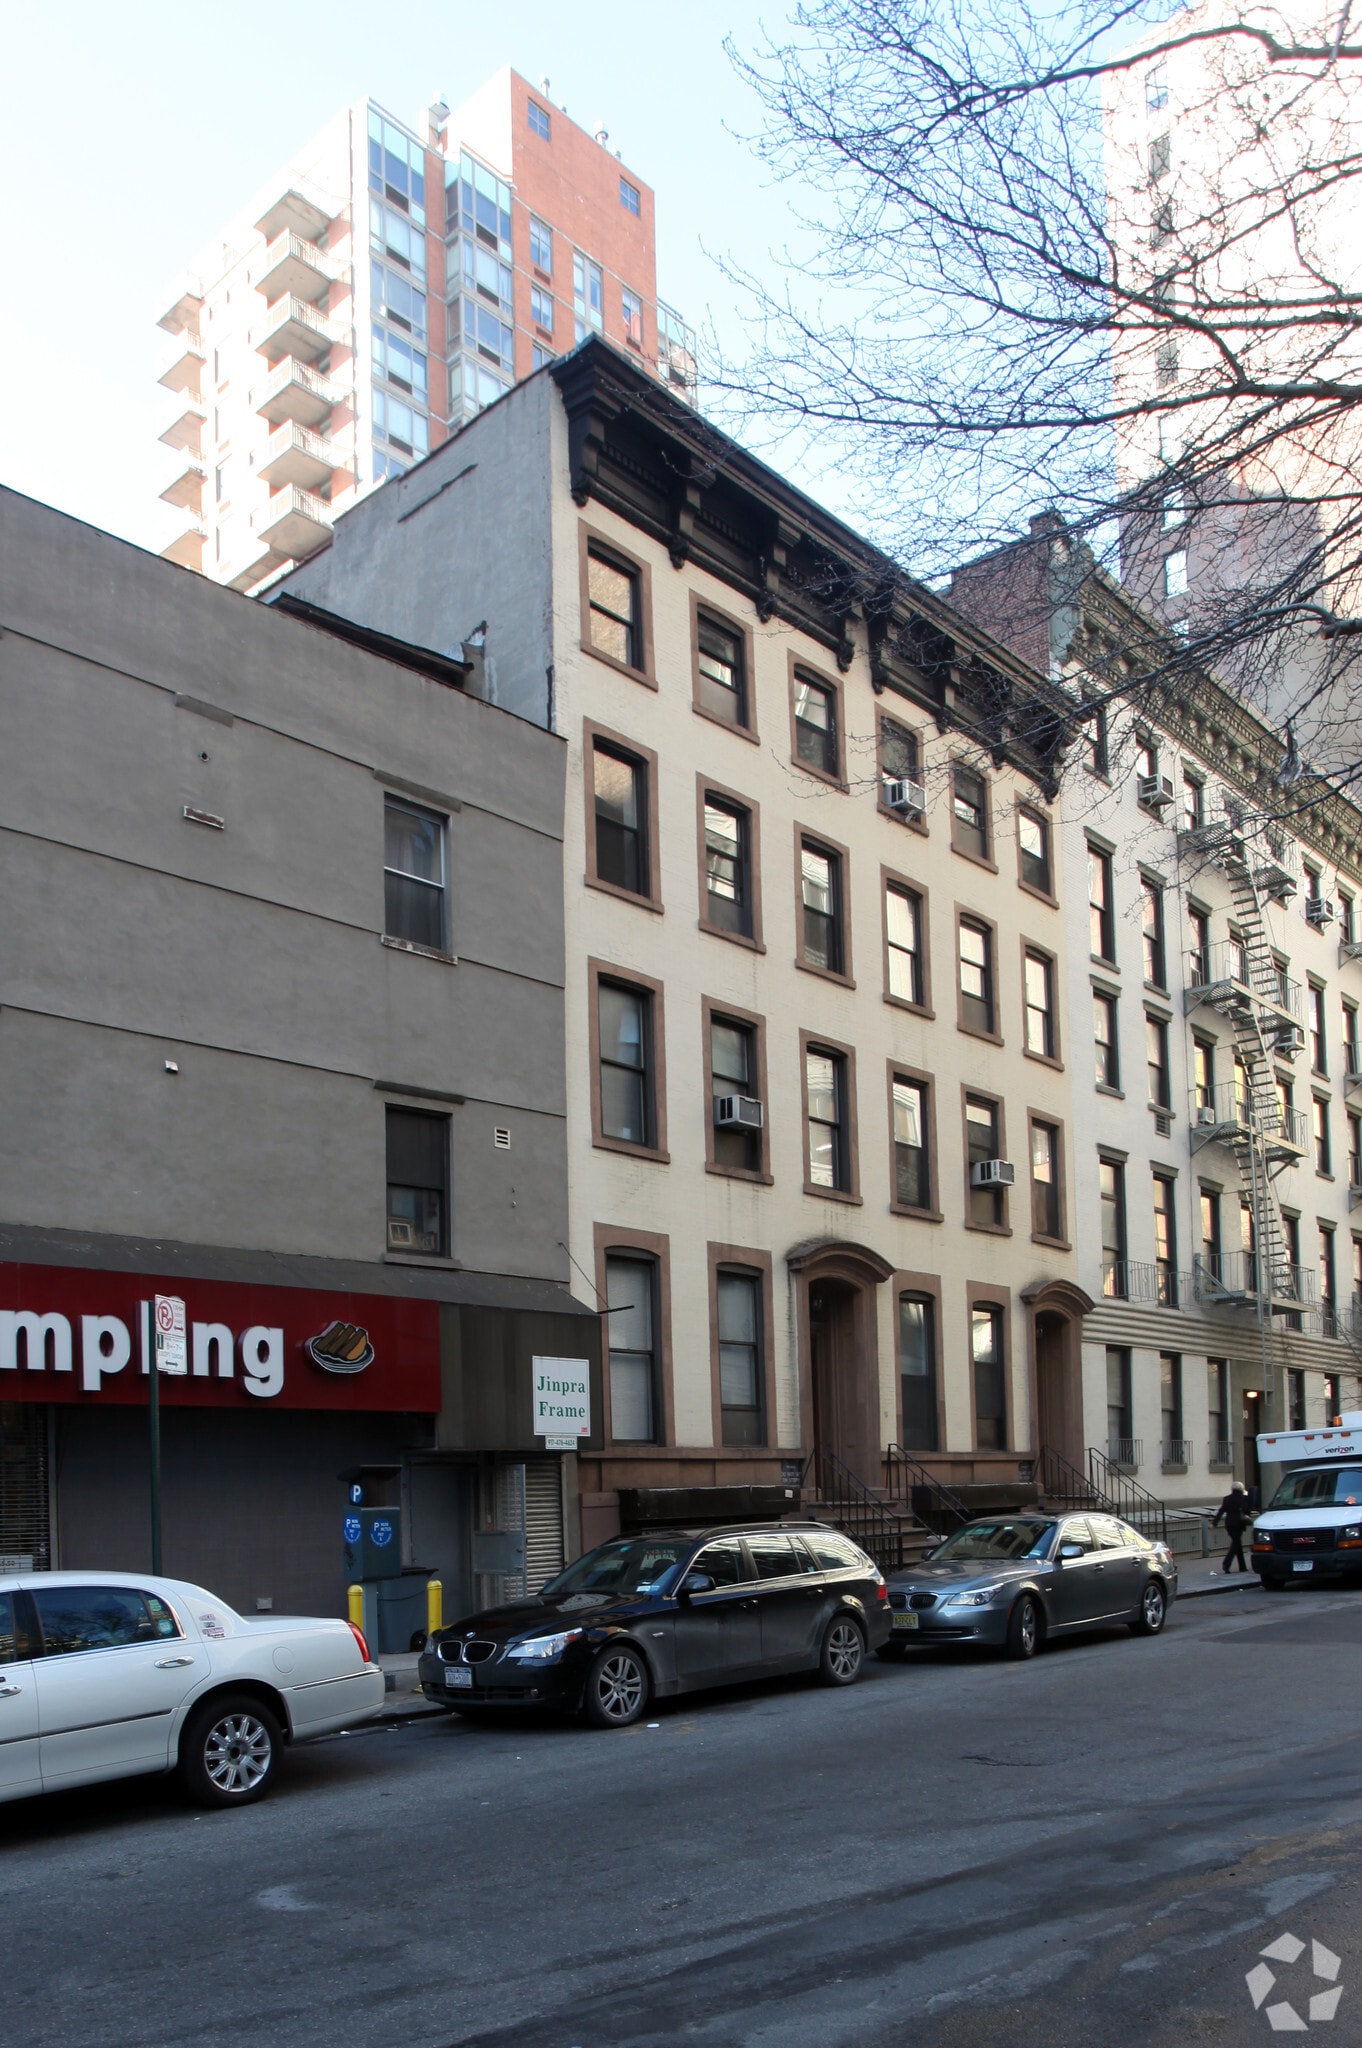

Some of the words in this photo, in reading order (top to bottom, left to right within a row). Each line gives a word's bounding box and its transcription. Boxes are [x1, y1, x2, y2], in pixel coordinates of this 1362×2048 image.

[0, 1300, 284, 1397] mplng
[537, 1375, 586, 1396] Jinpra
[539, 1401, 586, 1418] Frame
[1325, 1445, 1354, 1454] verizon
